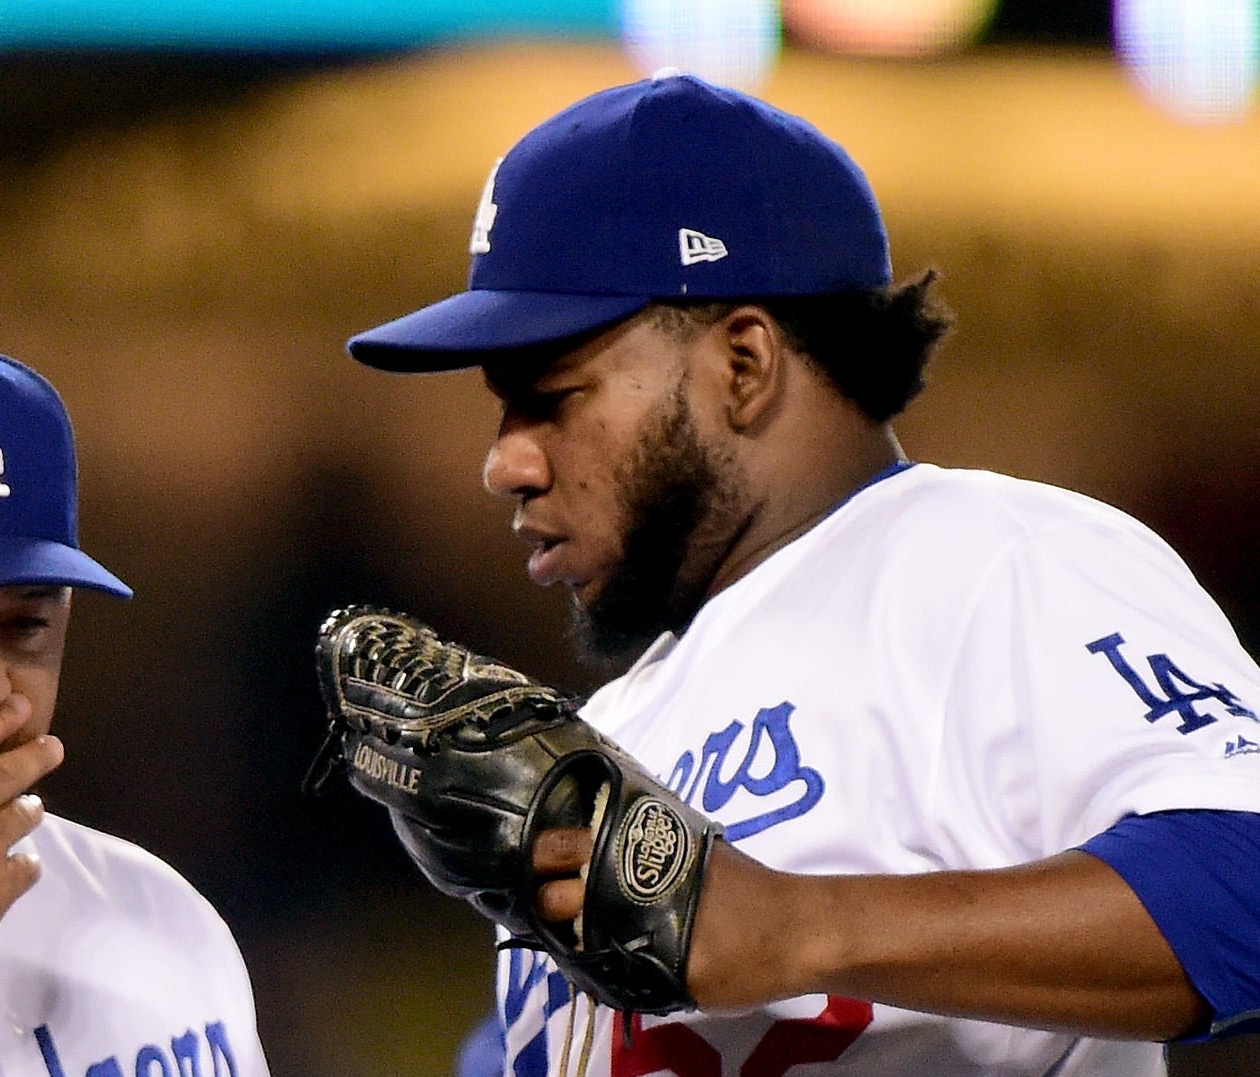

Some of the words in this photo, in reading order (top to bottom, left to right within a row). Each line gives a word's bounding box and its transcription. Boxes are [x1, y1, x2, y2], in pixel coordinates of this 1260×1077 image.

[1085, 632, 1260, 735] LA
[353, 742, 422, 795] LOUISVILLE
[637, 811, 677, 885] Slugger
